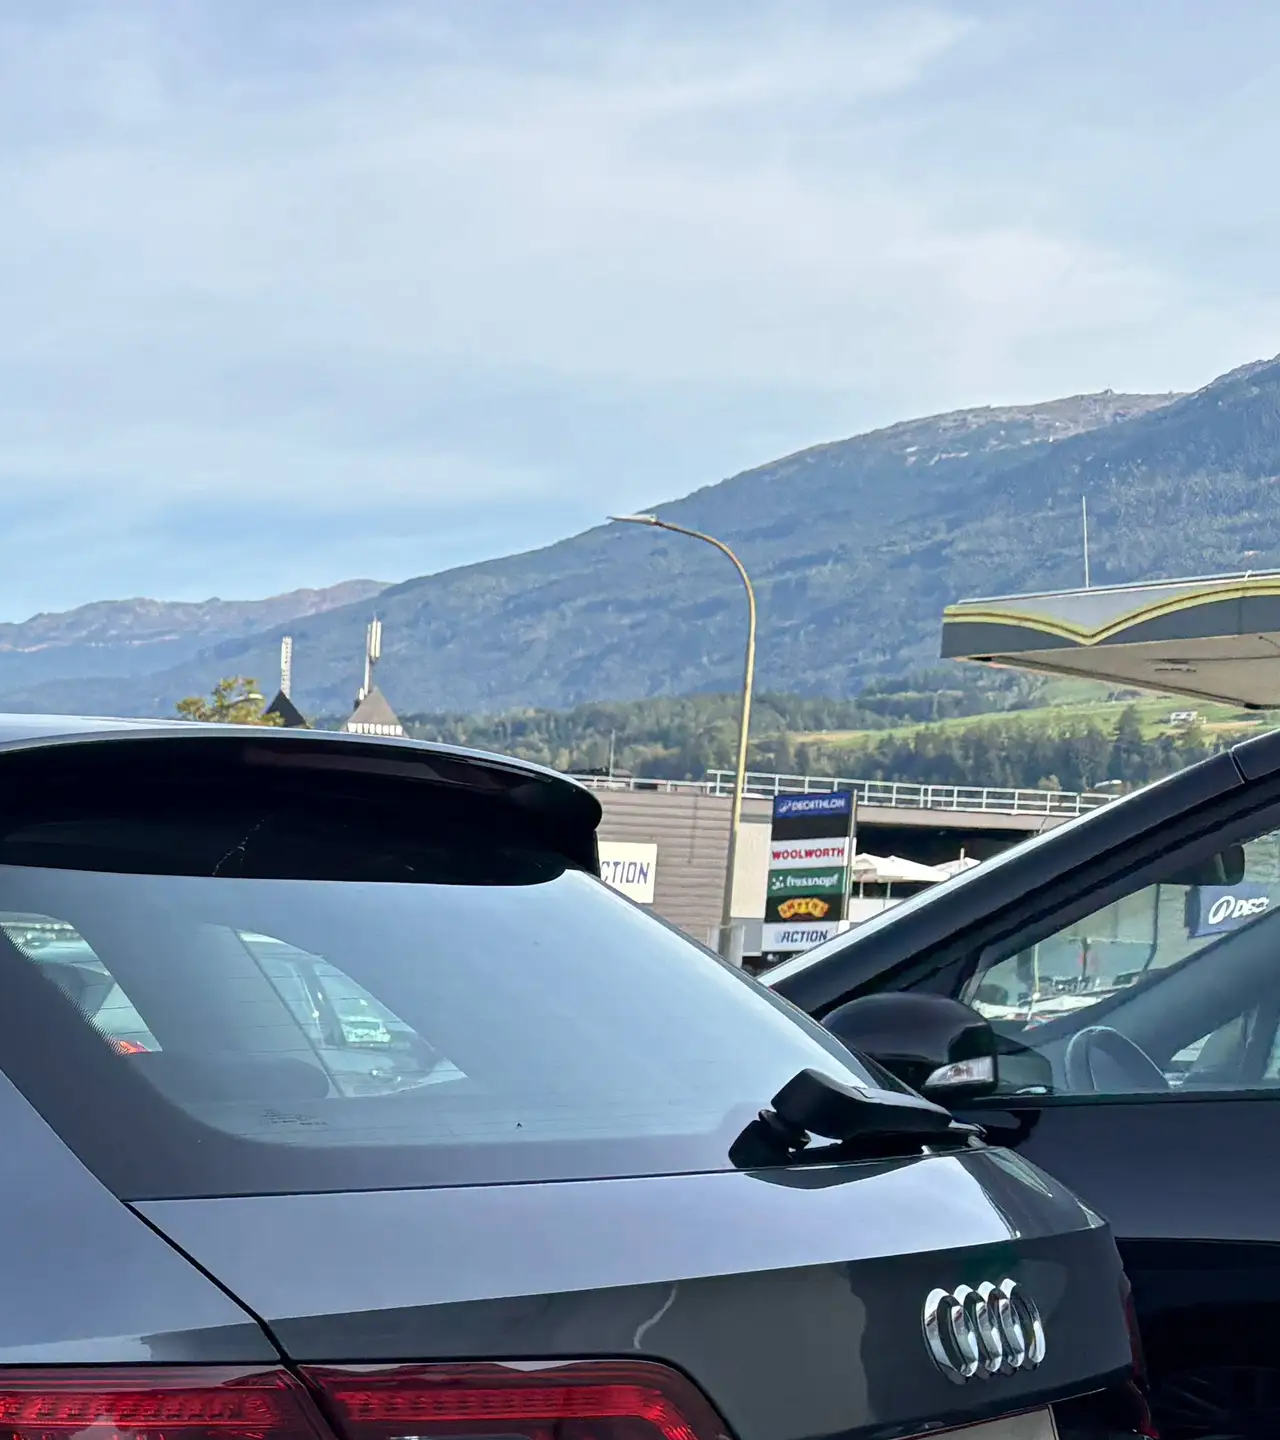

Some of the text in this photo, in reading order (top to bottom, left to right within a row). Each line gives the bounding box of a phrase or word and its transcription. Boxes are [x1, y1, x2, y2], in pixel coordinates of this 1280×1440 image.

[791, 798, 845, 811] DECATHLON
[771, 847, 845, 861] WOOLWORTH
[780, 929, 828, 944] ACTION
